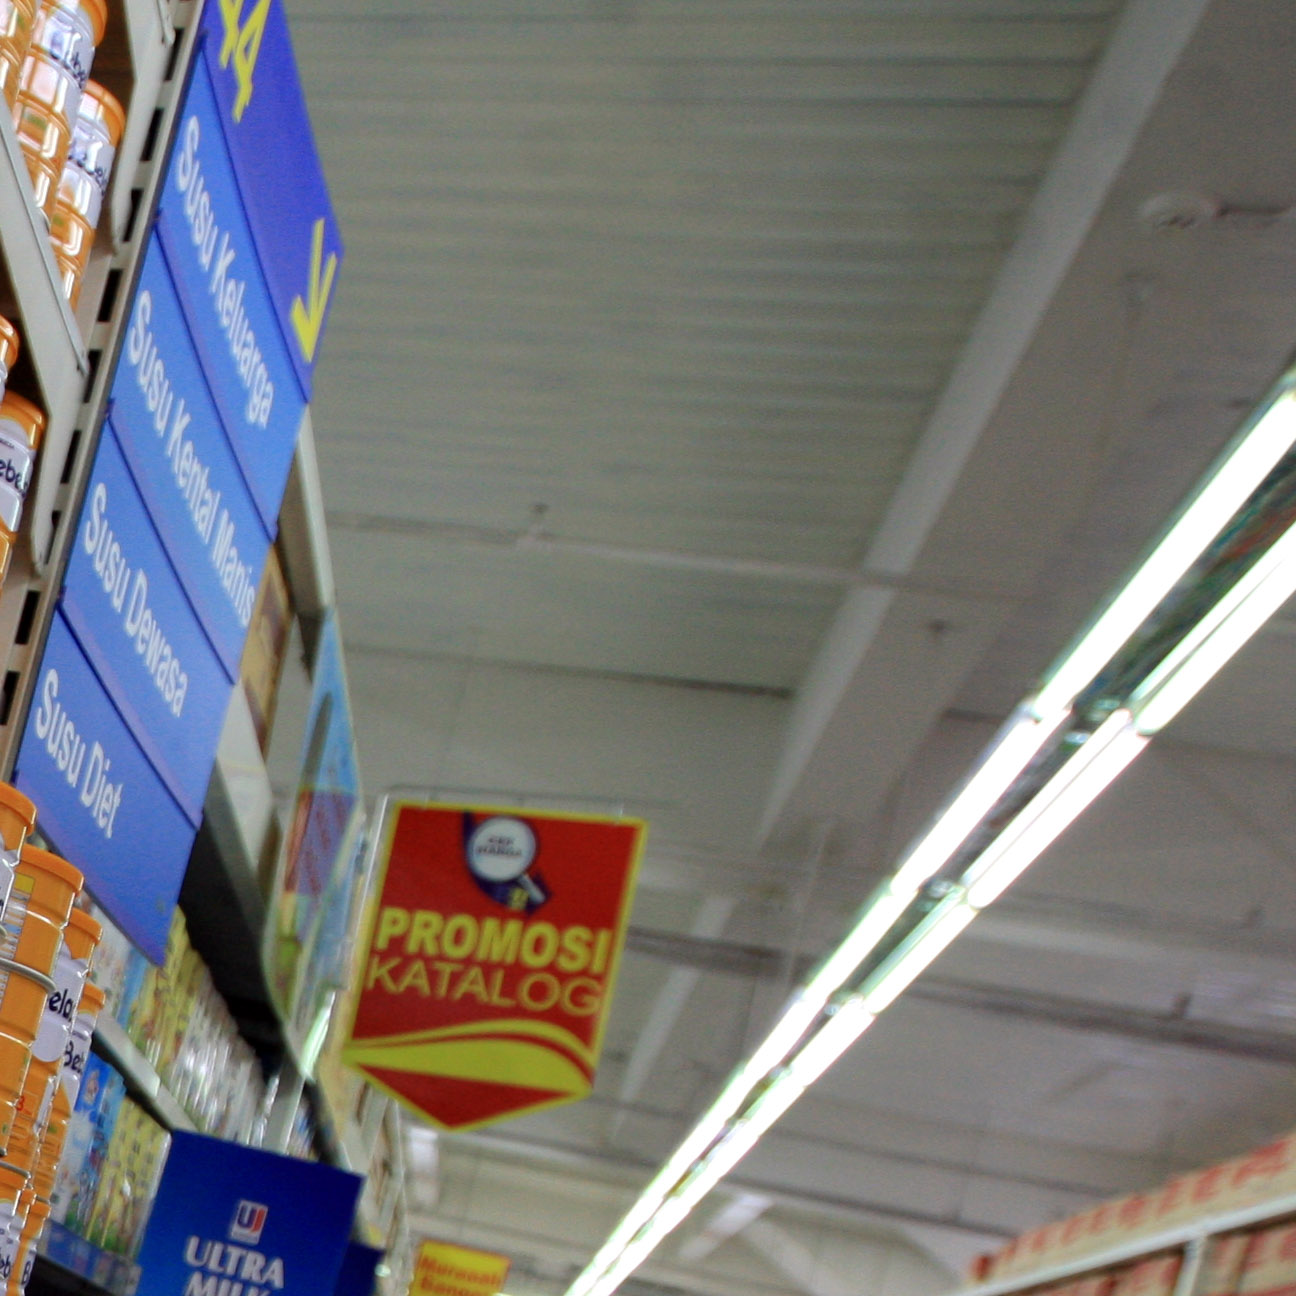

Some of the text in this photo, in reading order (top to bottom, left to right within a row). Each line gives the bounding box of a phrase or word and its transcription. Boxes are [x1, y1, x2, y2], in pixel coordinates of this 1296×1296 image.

[175, 115, 275, 429] Susu Keluarga
[127, 290, 256, 627] Susu Kental Manis
[84, 483, 188, 717] Susu Dewasa
[34, 669, 122, 839] Susu Diet
[366, 956, 601, 1016] KATALOG
[376, 906, 612, 974] PROMOSI
[185, 1235, 284, 1289] ULTRA
